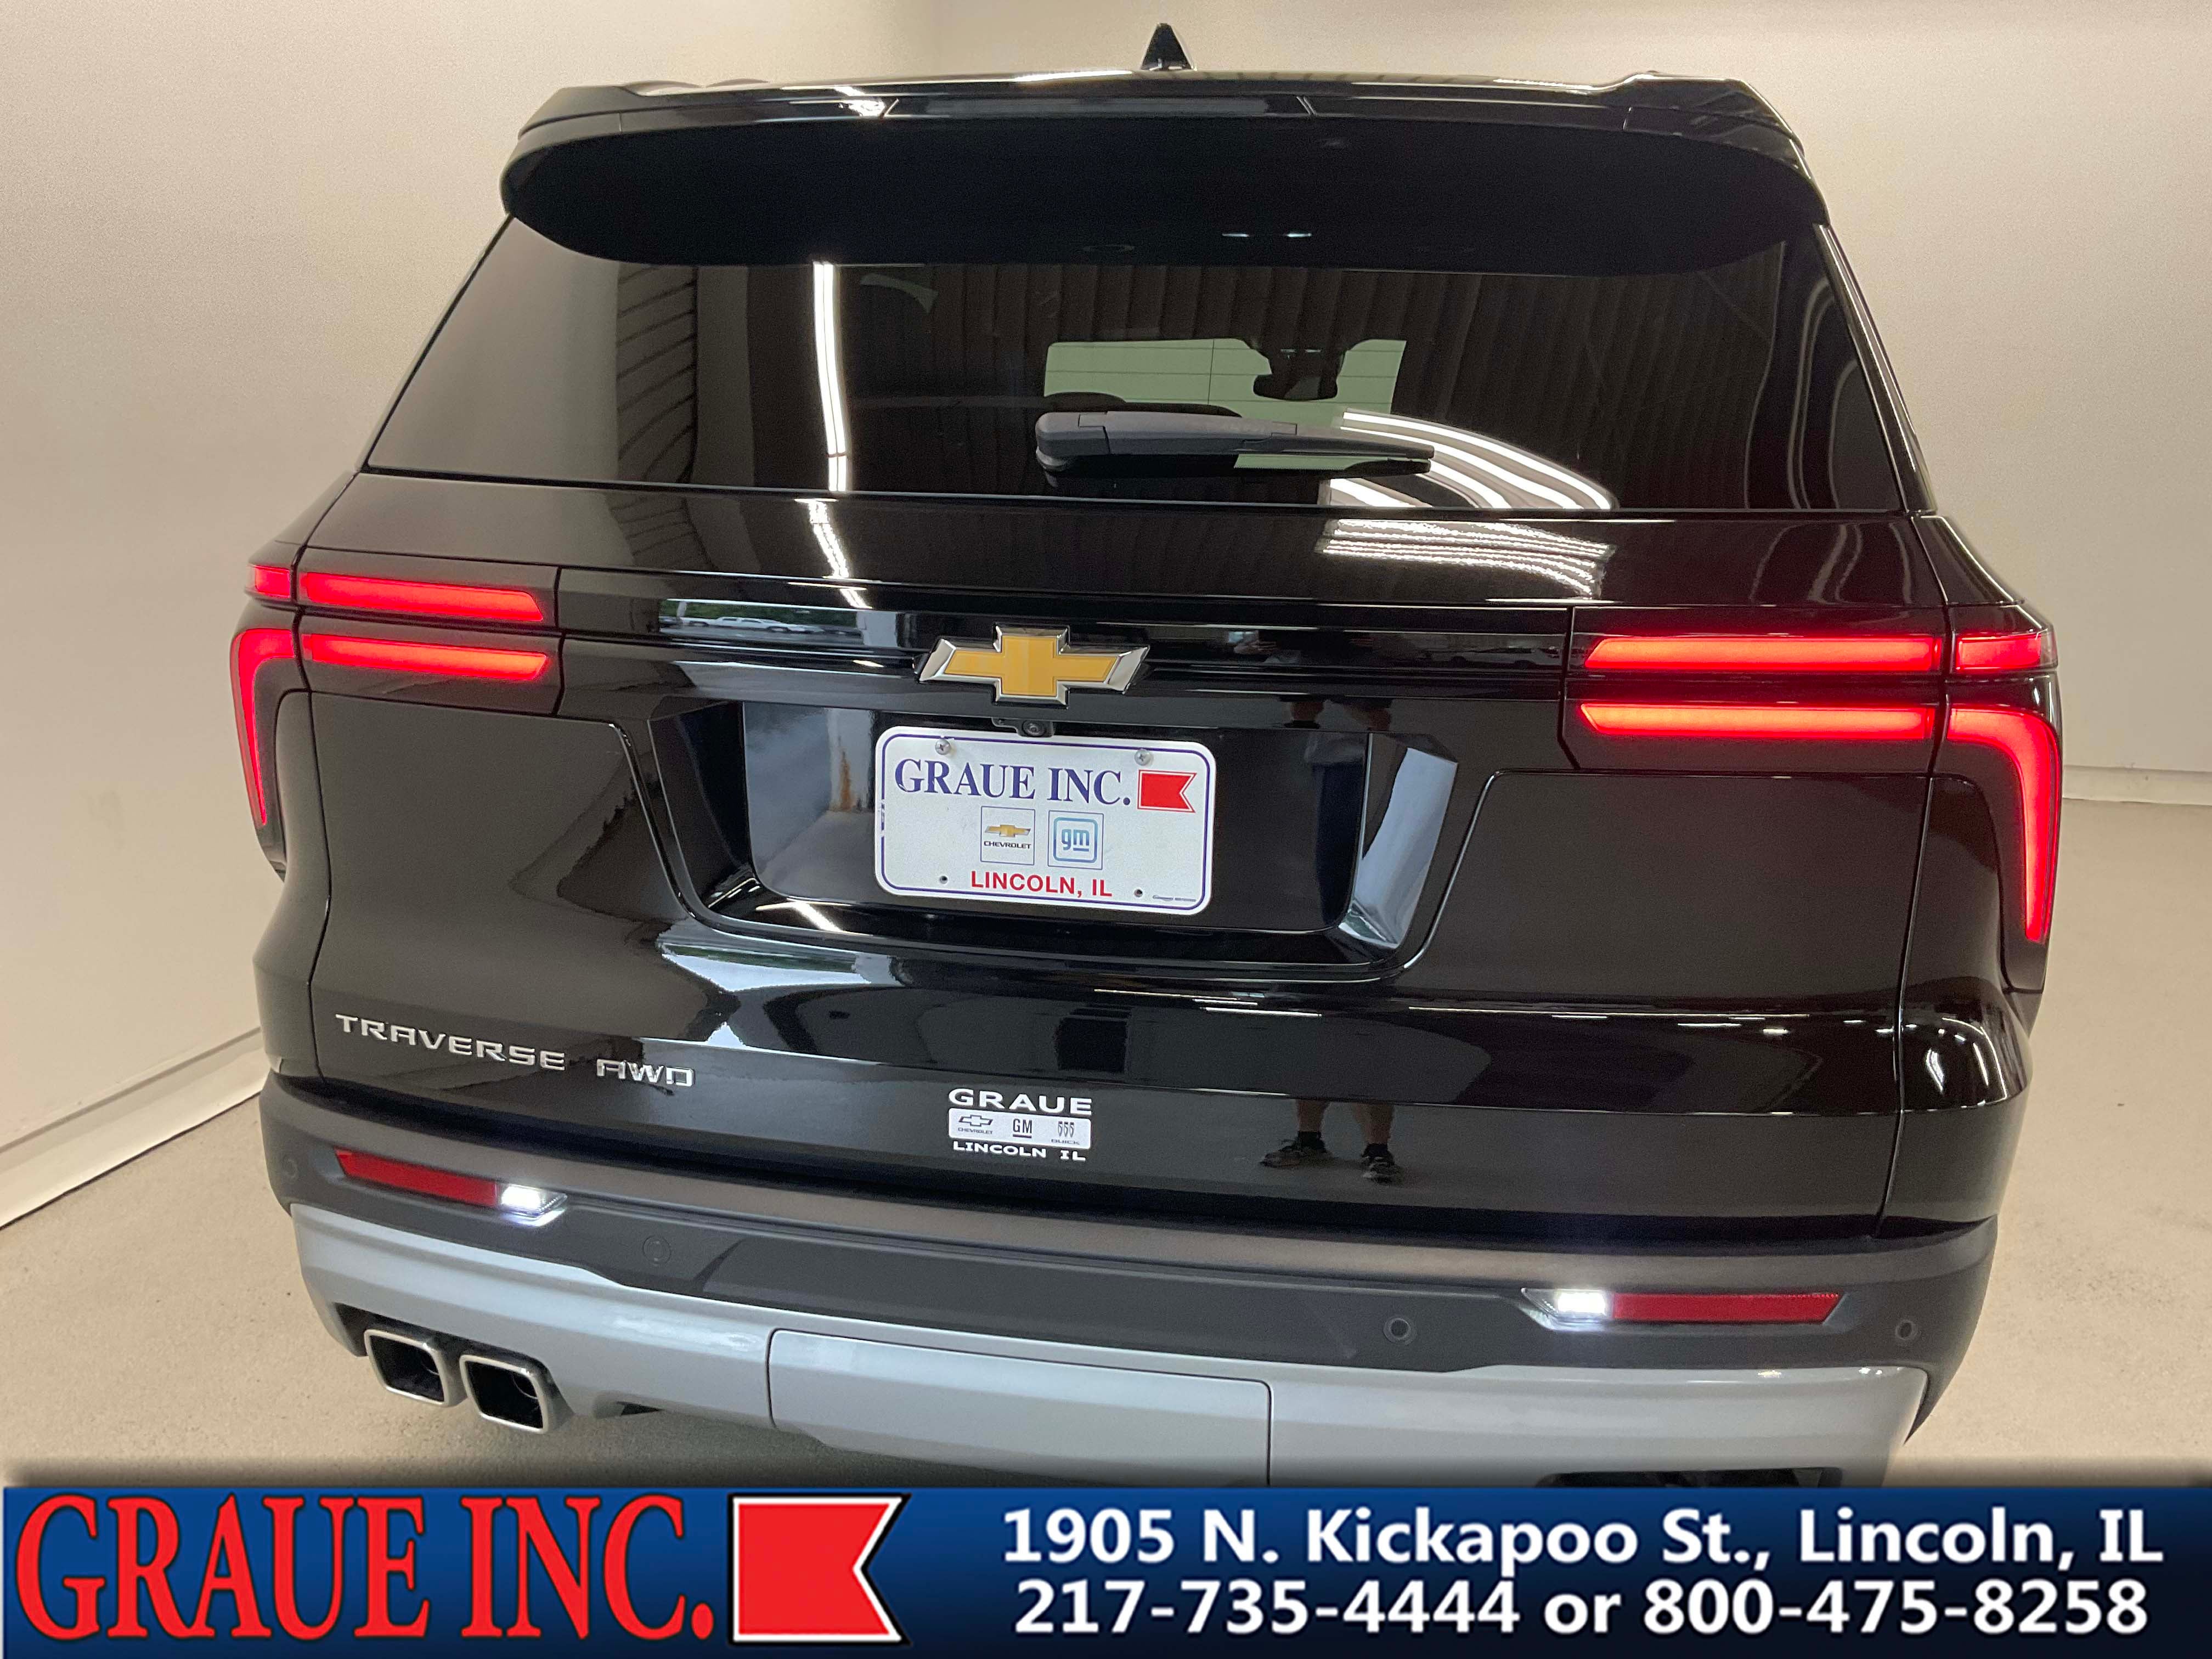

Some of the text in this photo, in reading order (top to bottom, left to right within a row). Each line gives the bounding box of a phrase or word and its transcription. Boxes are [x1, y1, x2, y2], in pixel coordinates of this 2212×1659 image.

[894, 758, 1131, 806] GRAUE INC.
[984, 840, 1032, 850] CHEVROLET
[1061, 828, 1090, 850] gm
[970, 870, 1113, 898] LINCOLN, IL
[335, 1013, 696, 1087] TRAVERSE AWD
[948, 1088, 1092, 1116] GRAUE
[957, 1126, 994, 1135] CHEVROLET
[1012, 1118, 1032, 1134] GM
[952, 1141, 1086, 1162] LINCOLN IL
